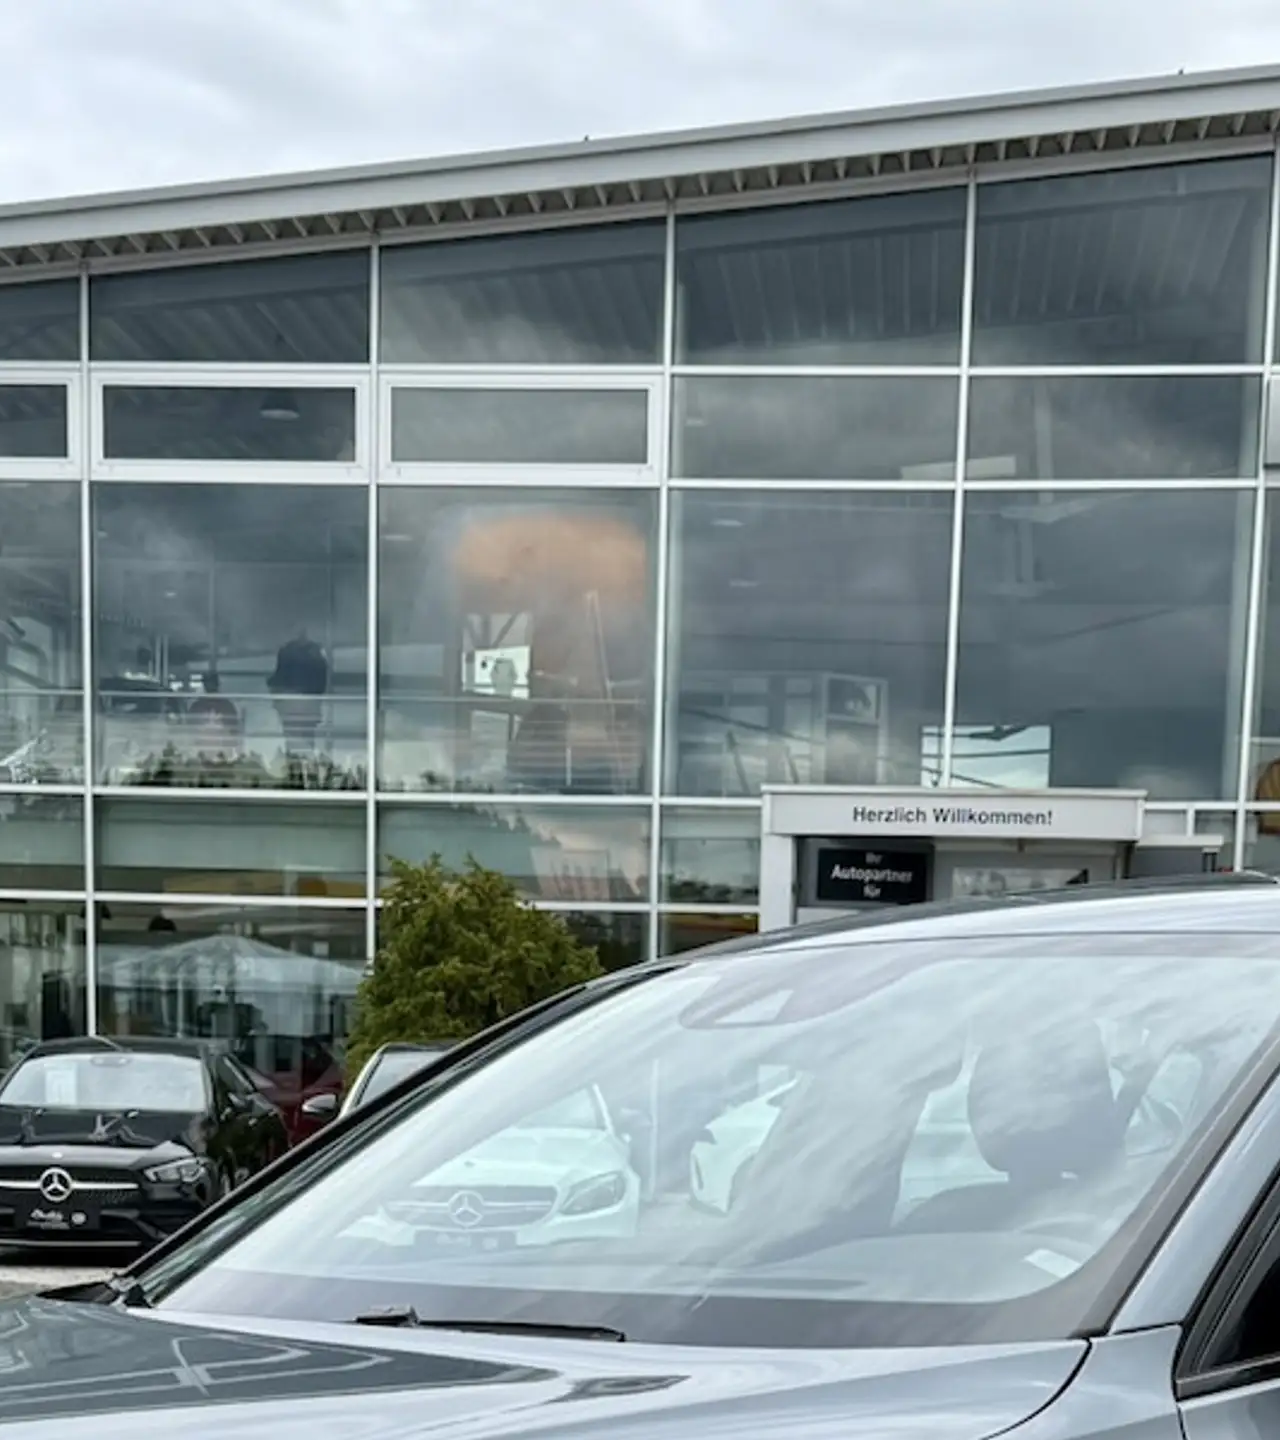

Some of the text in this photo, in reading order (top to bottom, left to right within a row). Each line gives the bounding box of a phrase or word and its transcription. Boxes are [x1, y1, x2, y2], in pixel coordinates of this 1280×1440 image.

[852, 805, 1054, 826] Herzlich Willkommen!
[830, 864, 913, 883] Autopartner
